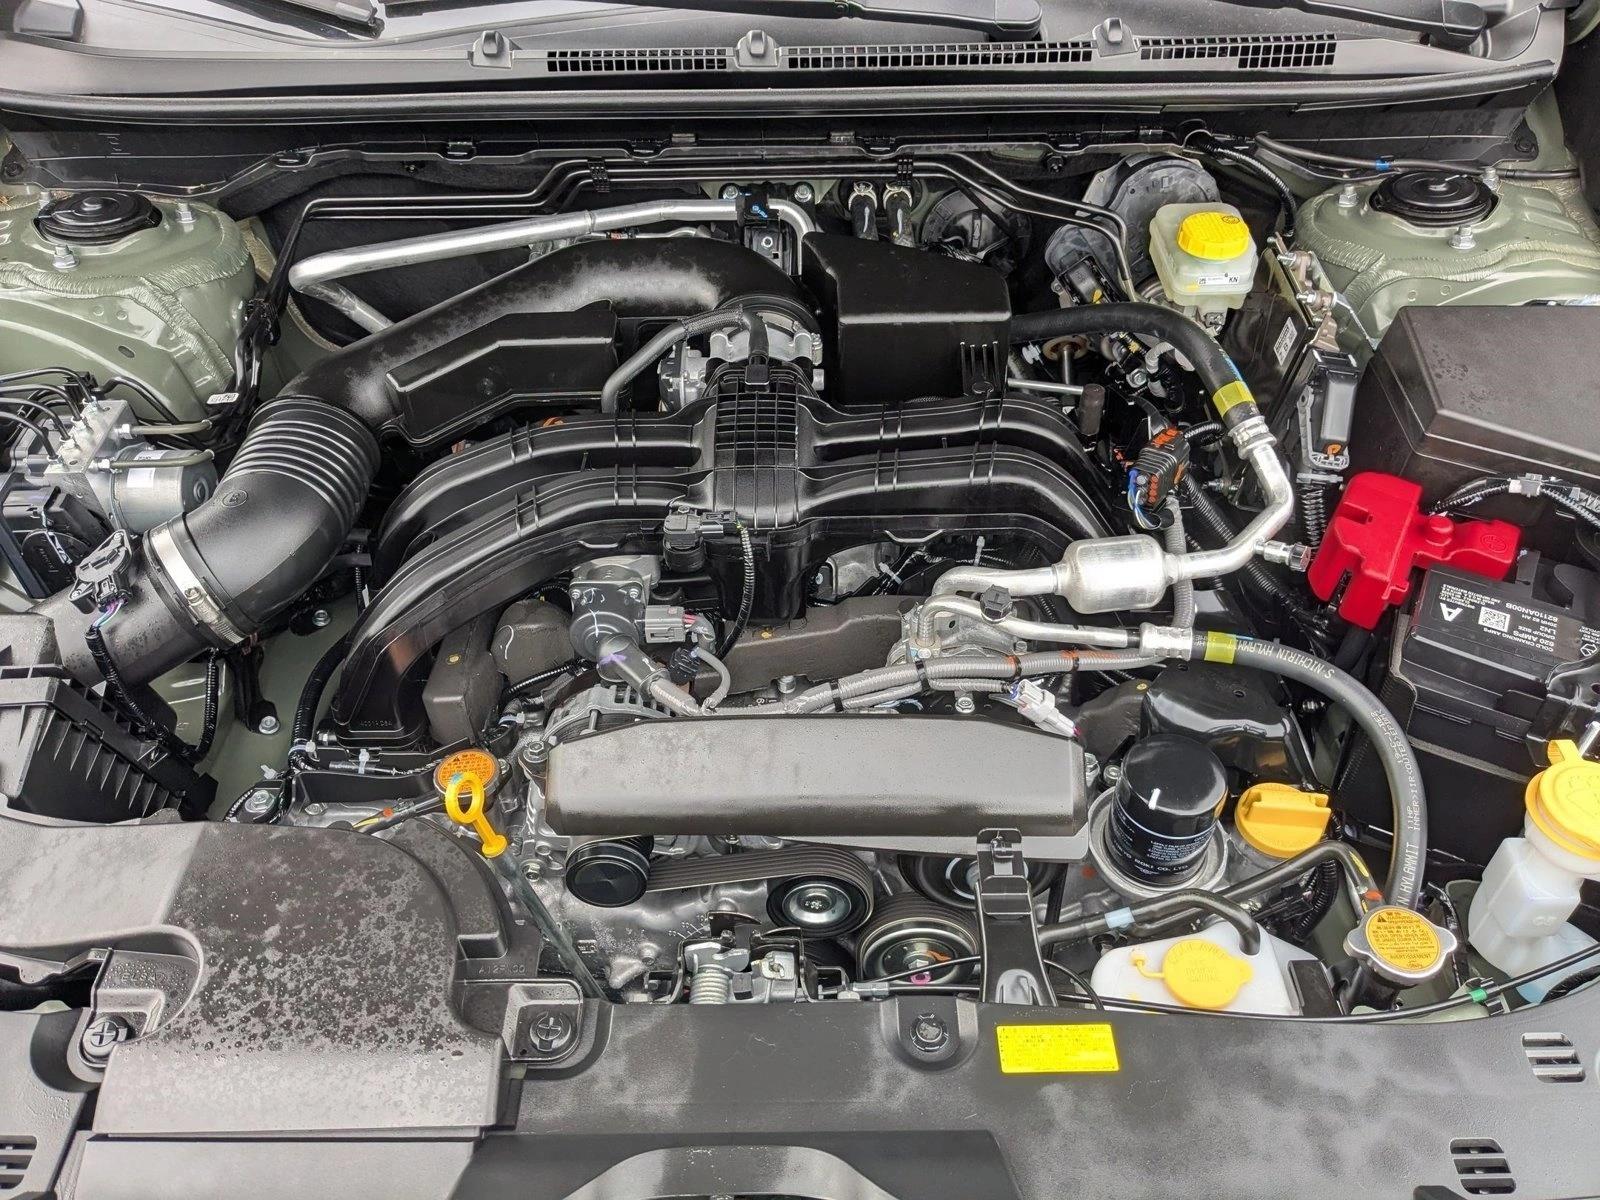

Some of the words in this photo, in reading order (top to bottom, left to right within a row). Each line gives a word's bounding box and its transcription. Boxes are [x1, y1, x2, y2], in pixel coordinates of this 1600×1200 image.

[1513, 630, 1538, 642] AMPS
[1540, 625, 1556, 635] LN2
[1502, 633, 1535, 646] CRANKING
[1535, 643, 1554, 652] COLD
[1399, 842, 1420, 894] HYLAMMIT
